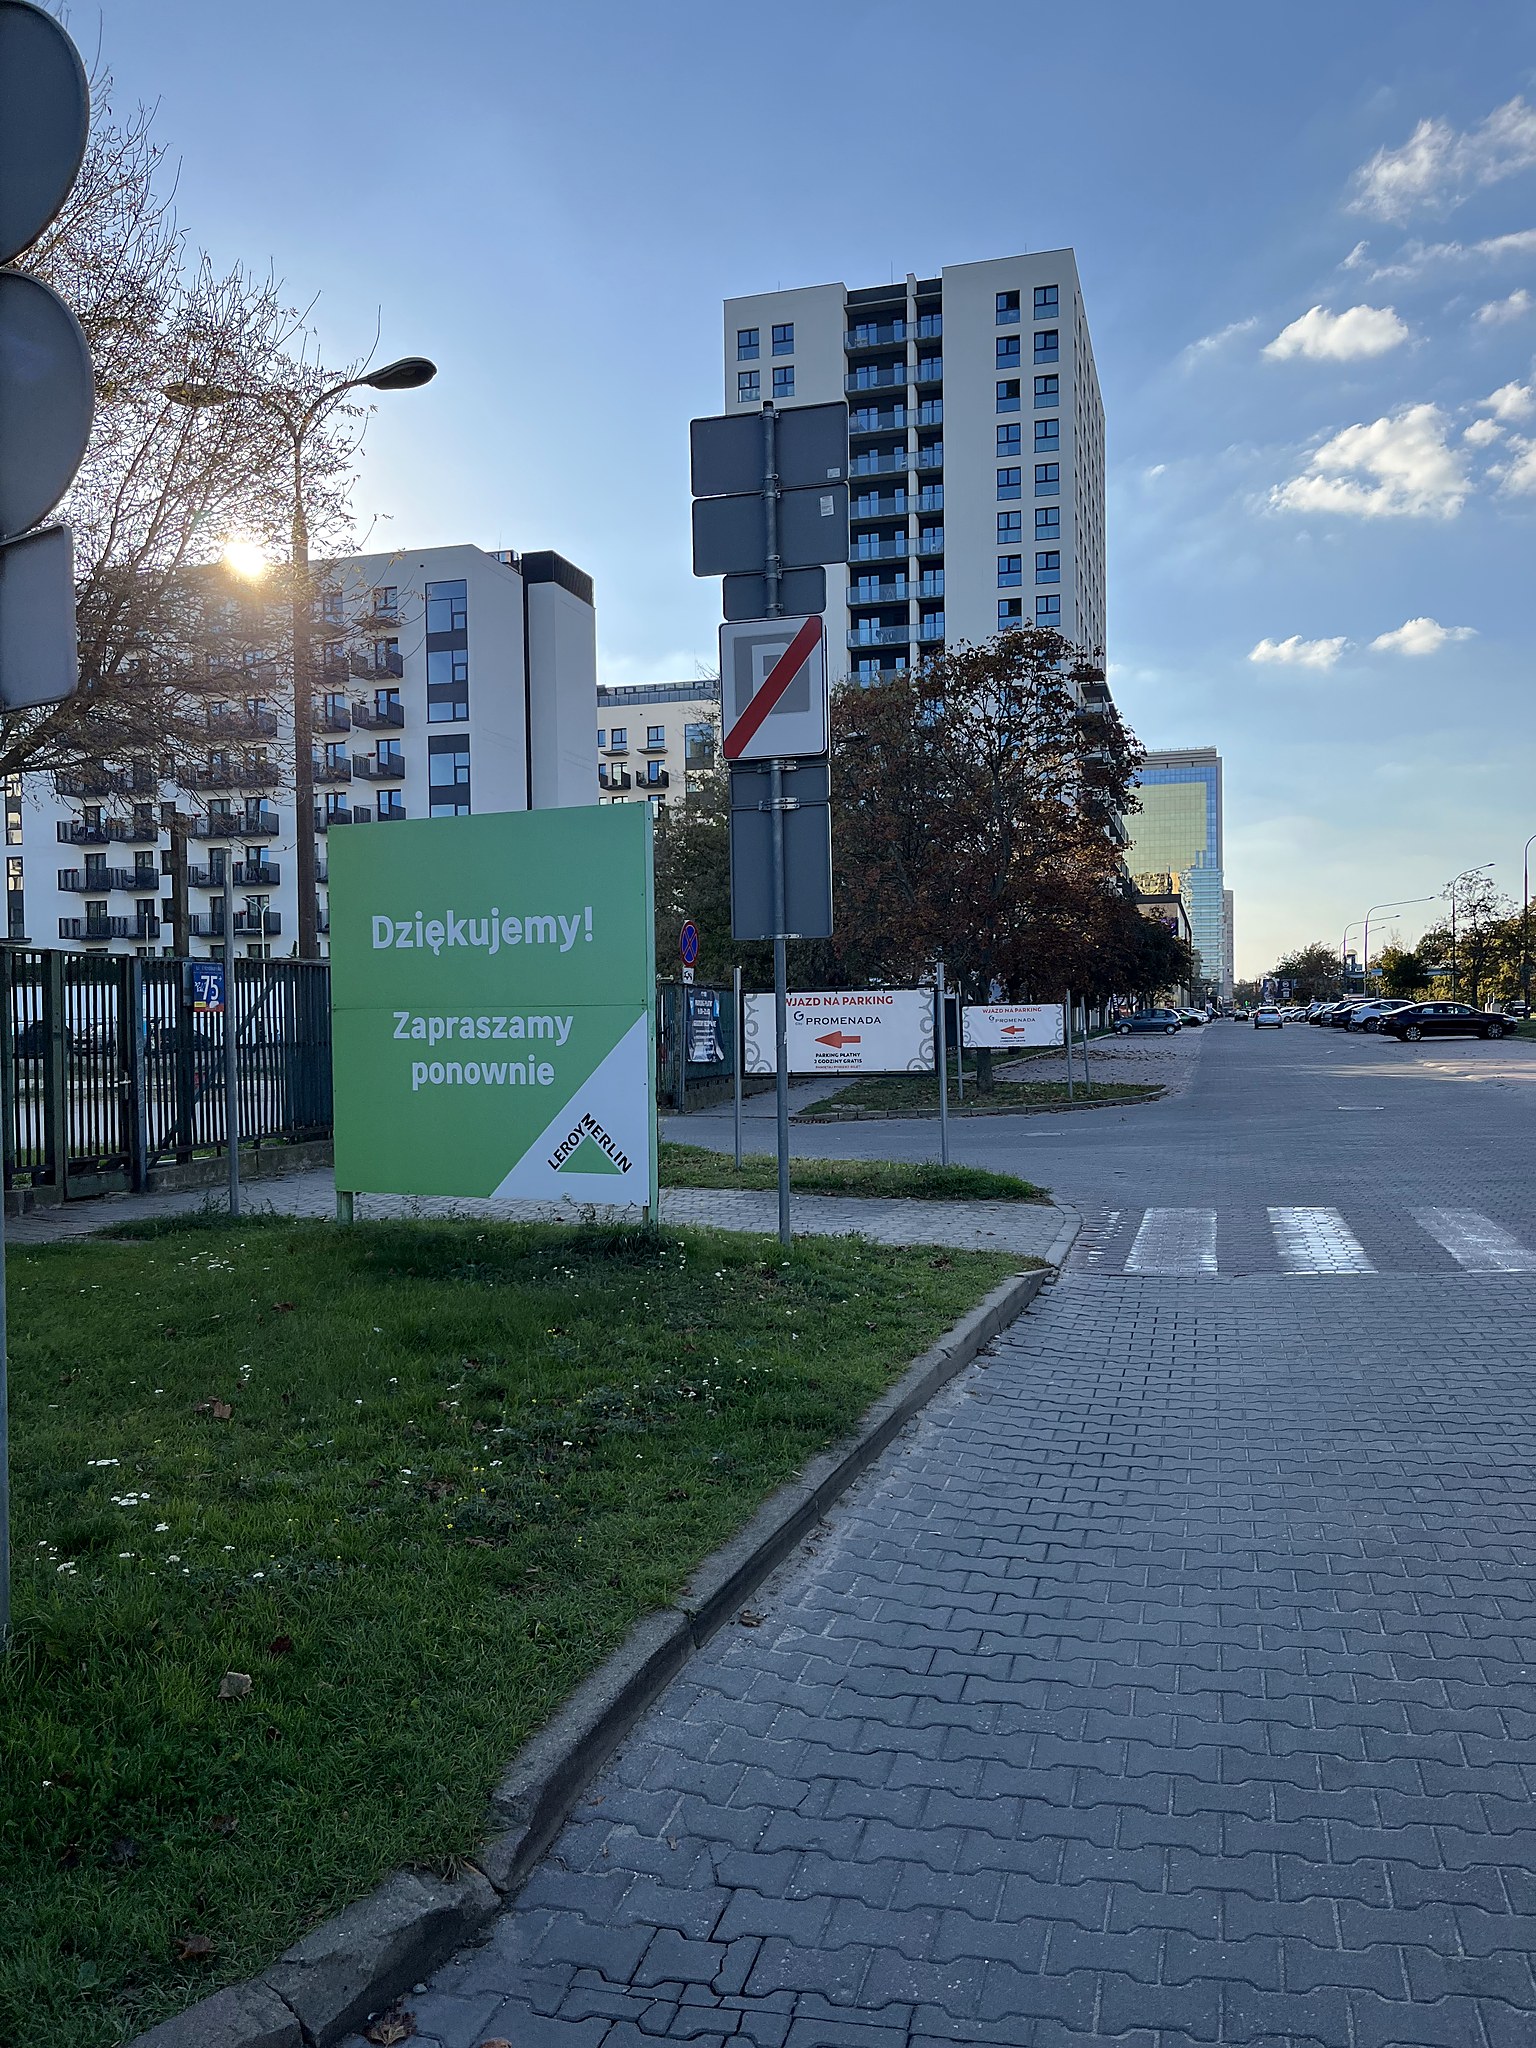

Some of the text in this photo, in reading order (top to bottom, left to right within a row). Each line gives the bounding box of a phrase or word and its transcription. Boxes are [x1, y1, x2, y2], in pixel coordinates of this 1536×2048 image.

[371, 906, 593, 956] Dziękujemy!
[823, 997, 840, 1006] NA
[842, 995, 893, 1006] PARKING
[393, 1011, 574, 1047] Zapraszamy
[806, 1016, 882, 1026] PROMENADA
[412, 1054, 555, 1091] ponownie
[547, 1112, 633, 1174] LEROY MERLIN
